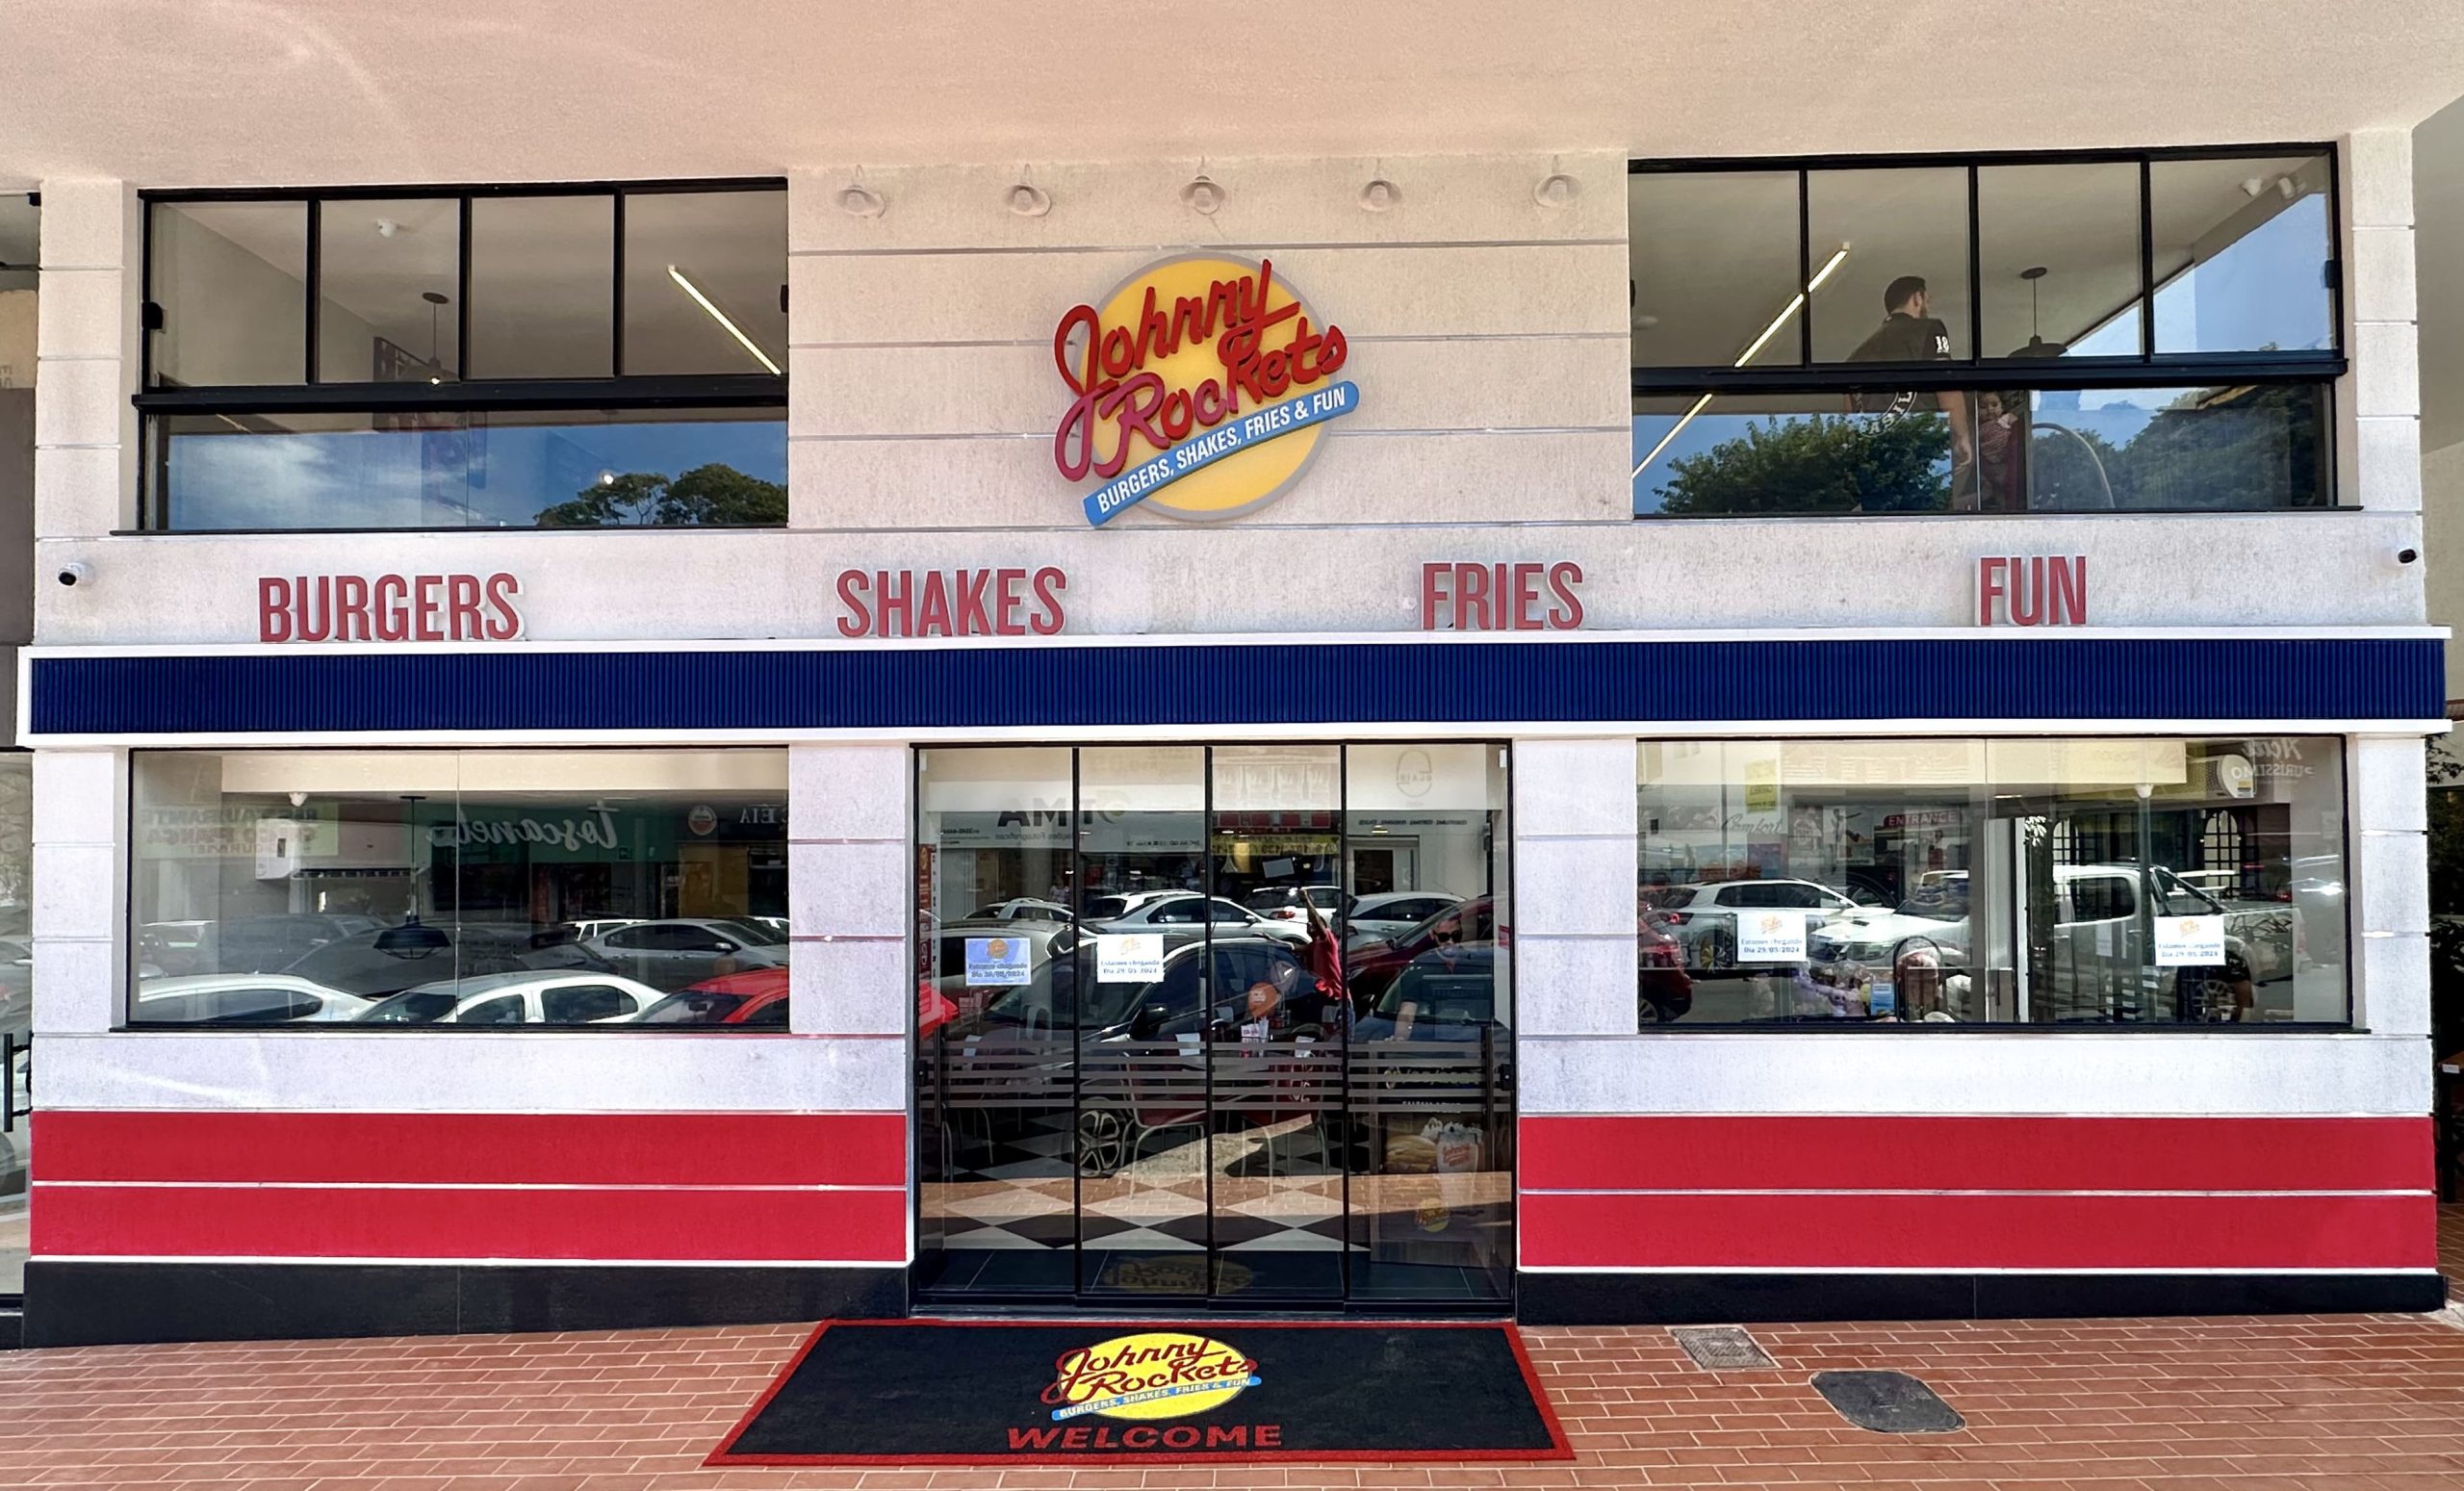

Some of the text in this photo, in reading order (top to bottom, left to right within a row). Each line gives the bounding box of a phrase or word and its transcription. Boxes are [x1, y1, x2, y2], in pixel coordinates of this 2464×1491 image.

[1054, 259, 1300, 481] Johnny
[1093, 316, 1348, 478] Rockets
[1096, 386, 1347, 514] BURGERS, SHAKES, FRIES & FUN
[258, 572, 523, 643] BURGERS
[836, 567, 1066, 637] SHAKES
[1421, 561, 1584, 630] FRIES
[1976, 556, 2087, 626] FUN
[1887, 810, 1959, 827] ENTRANCE
[1040, 1338, 1227, 1404] Johnny
[1076, 1356, 1259, 1402] Rockets
[1226, 1378, 1250, 1388] FUN
[1007, 1425, 1282, 1450] WELCOME
